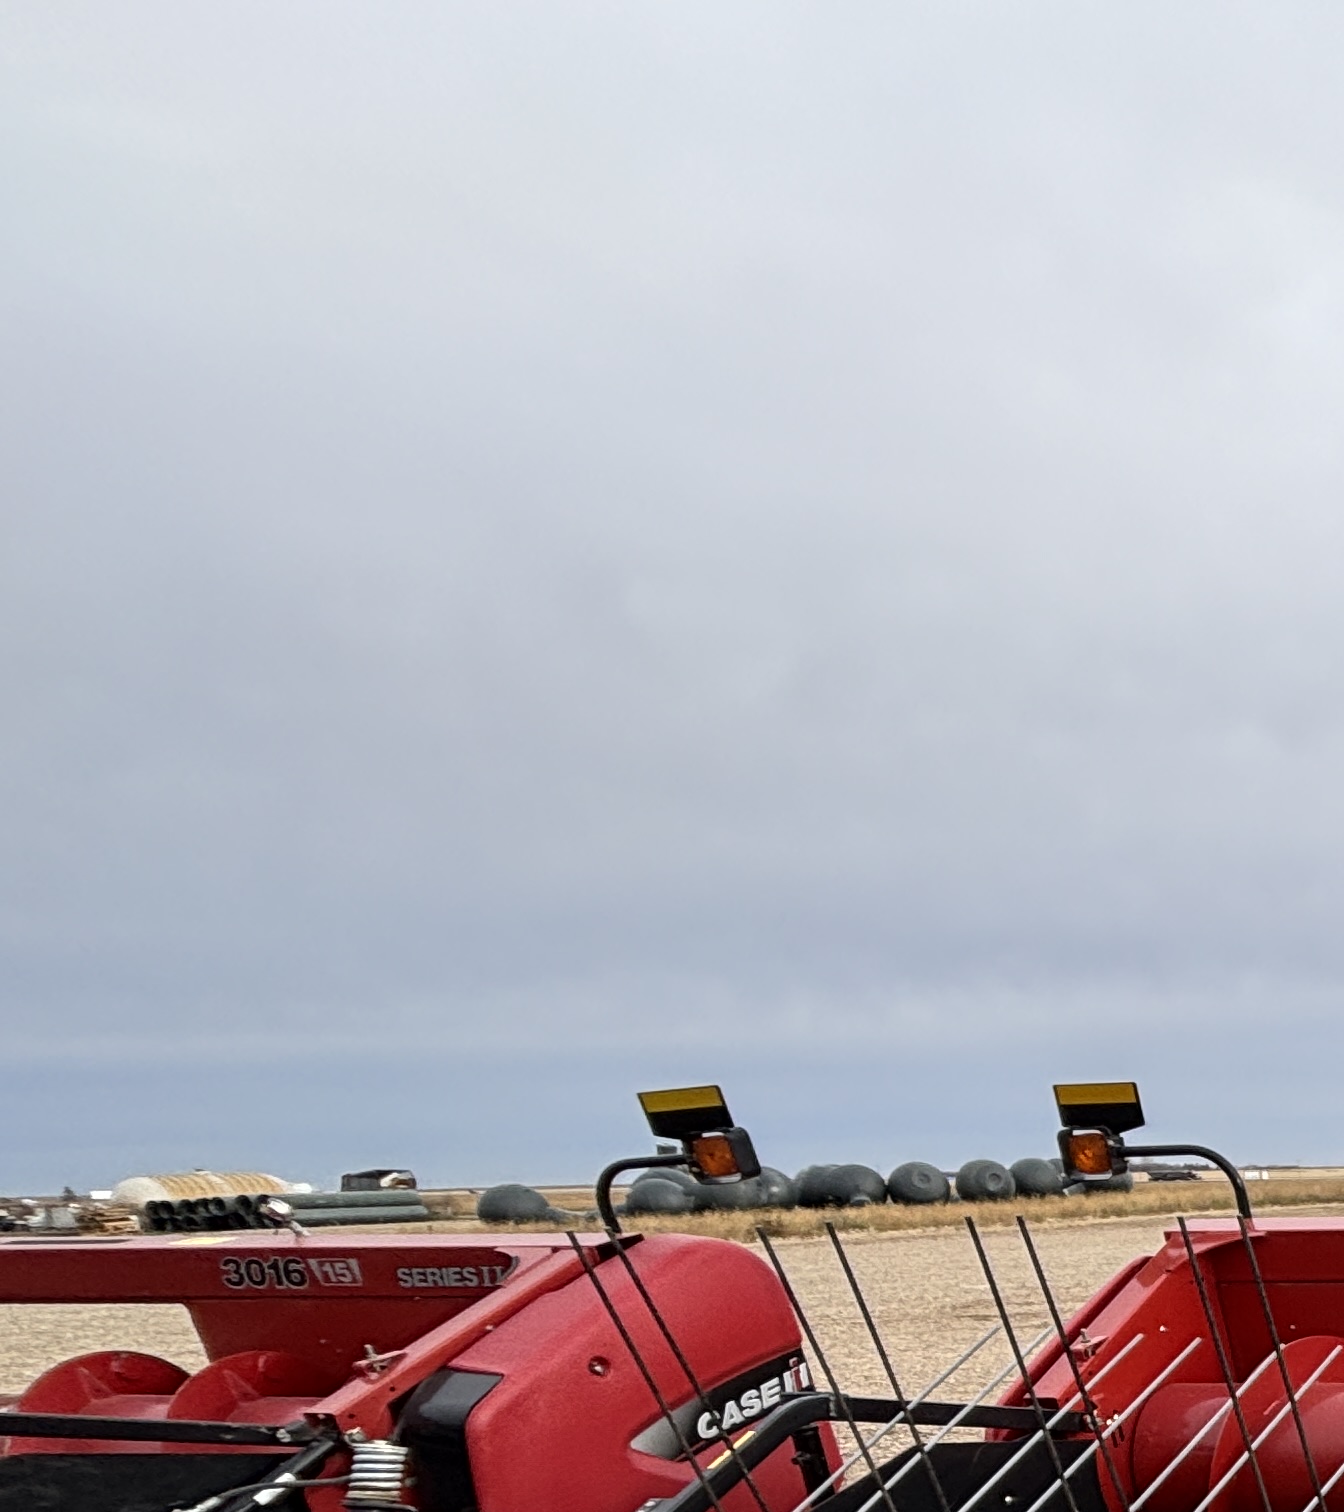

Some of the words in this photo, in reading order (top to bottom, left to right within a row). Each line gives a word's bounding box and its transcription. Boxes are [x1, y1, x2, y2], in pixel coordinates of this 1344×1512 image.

[221, 1257, 308, 1288] 3016
[321, 1261, 351, 1283] 15
[397, 1267, 476, 1287] SERIES
[697, 1377, 782, 1439] CASE
